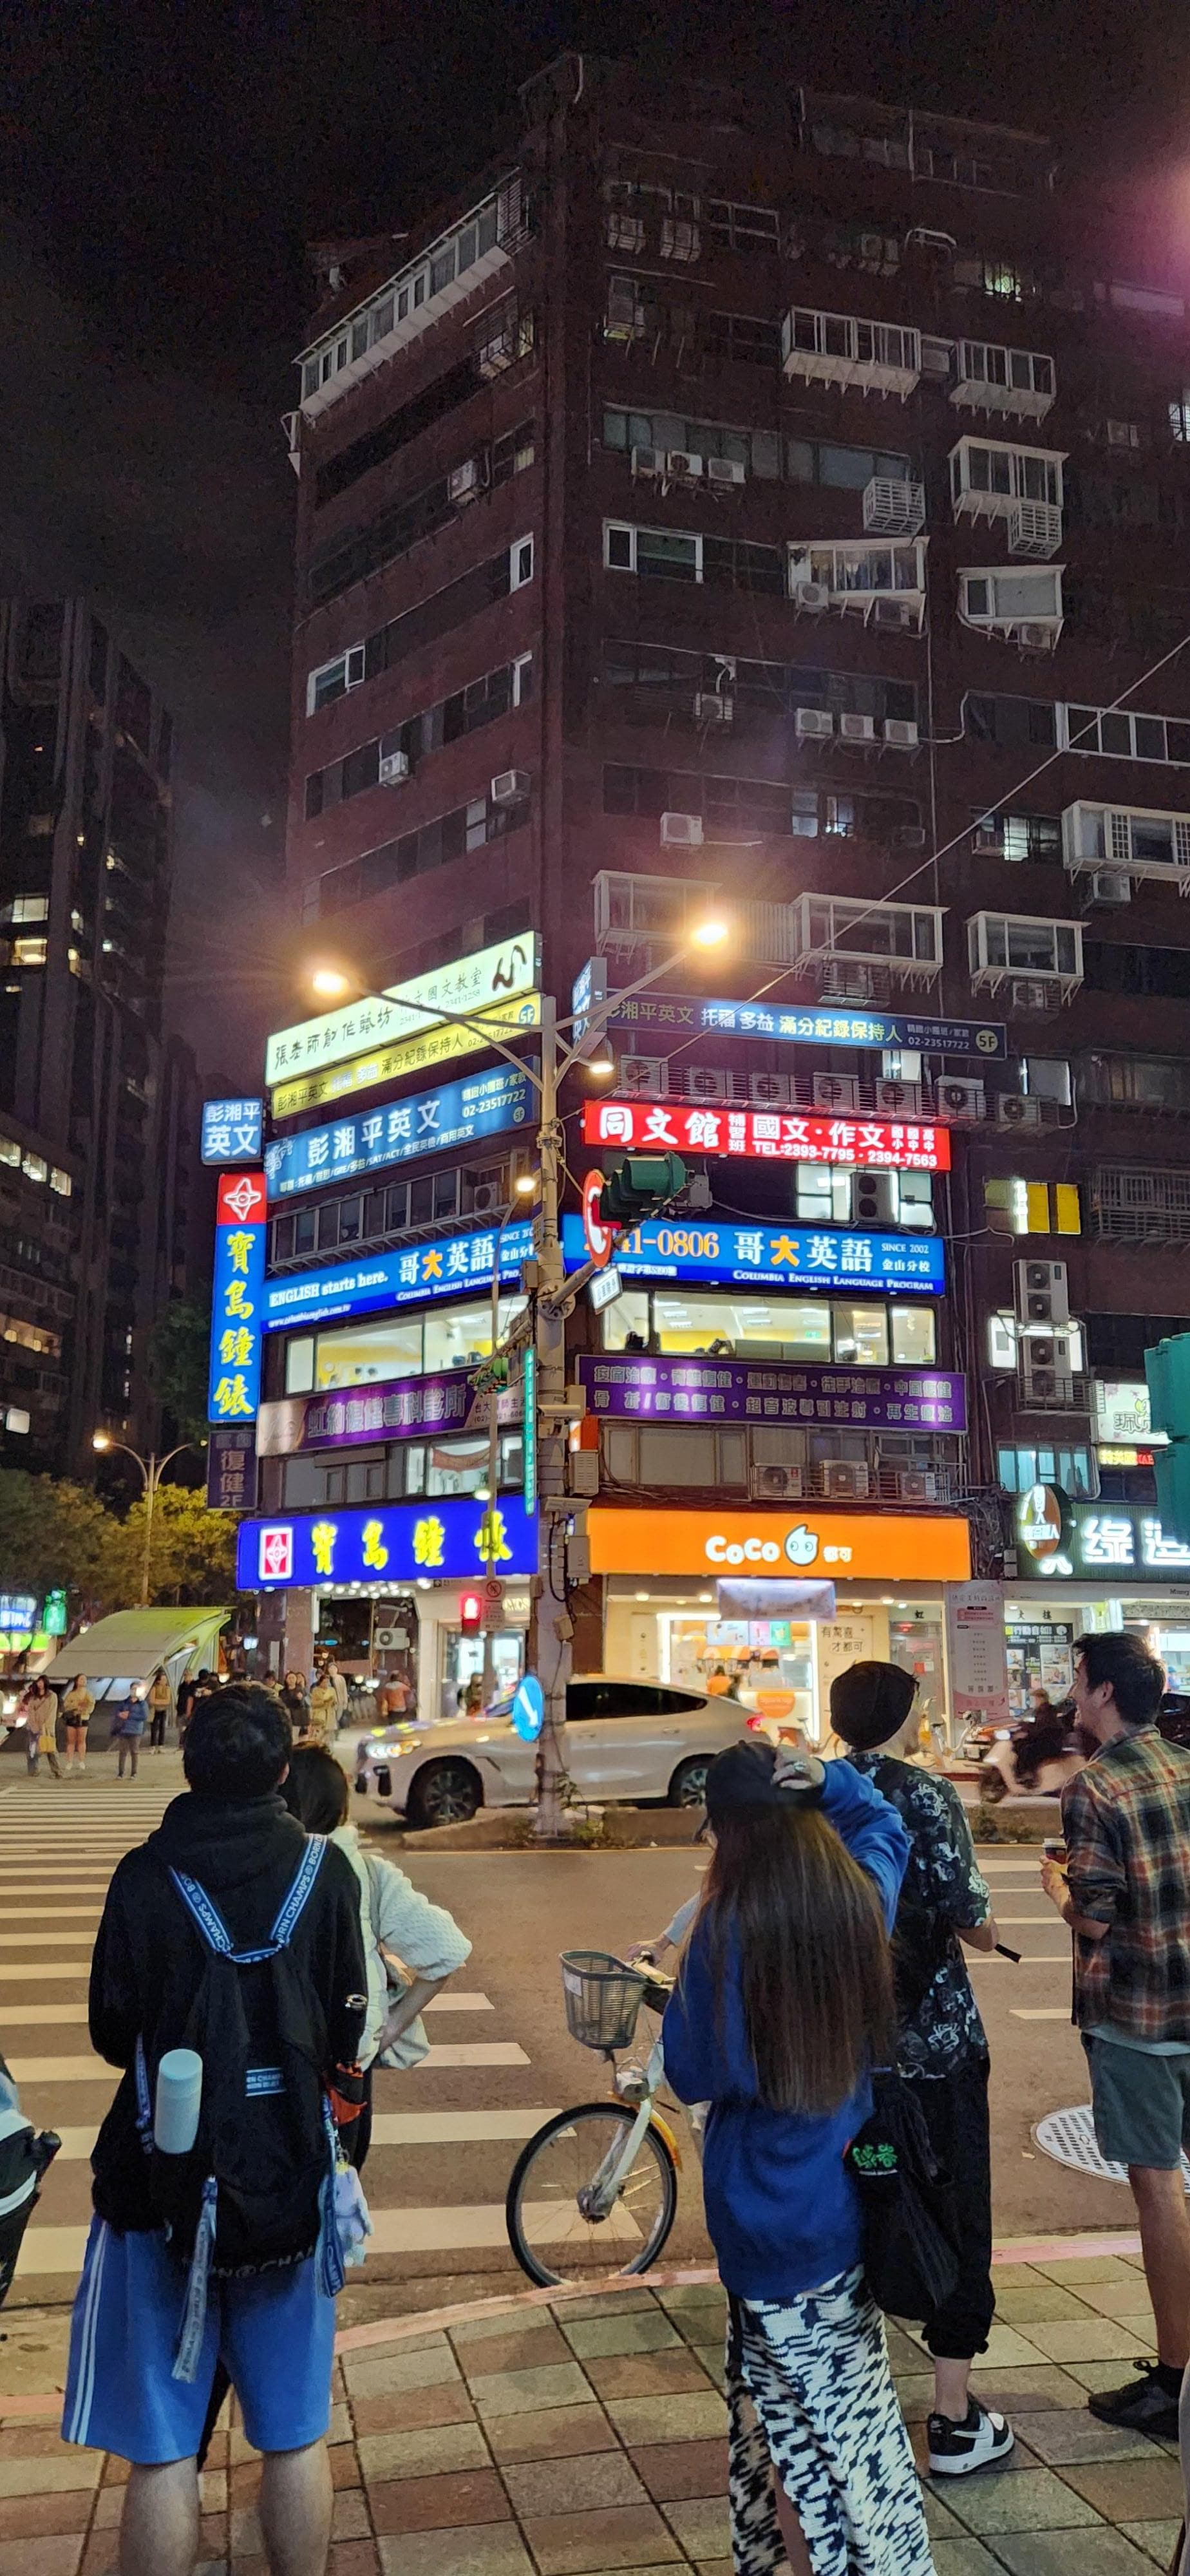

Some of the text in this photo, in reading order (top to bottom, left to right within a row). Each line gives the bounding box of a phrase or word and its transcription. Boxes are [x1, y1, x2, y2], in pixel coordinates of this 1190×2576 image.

[701, 1008, 735, 1028] 托福
[740, 1011, 774, 1032] 多益
[779, 1015, 902, 1043] 滿分紀錄保持人
[979, 1034, 996, 1047] 5F
[381, 1032, 463, 1075] 滿分紀錄保持人
[908, 1036, 970, 1050] 02-23517722
[205, 1102, 260, 1123] 彭湘平
[462, 1088, 526, 1118] 02-23517722
[205, 1124, 258, 1157] 英文
[307, 1099, 440, 1168] 彭湘平英文
[600, 1106, 721, 1149] 同文館
[922, 1128, 935, 1153] 高中
[868, 1149, 938, 1168] 2394-7563
[399, 1233, 495, 1285] 哥大英語
[733, 1231, 873, 1273] 哥大英語
[881, 1243, 929, 1255] SINCE 2002
[882, 1258, 931, 1273] 金山分校
[269, 1270, 390, 1309] ENGLISH starts here.
[220, 1450, 245, 1493] 復健
[220, 1494, 243, 1507] 2F
[705, 1535, 781, 1565] CoCo
[286, 1875, 310, 1918] CHAMPS
